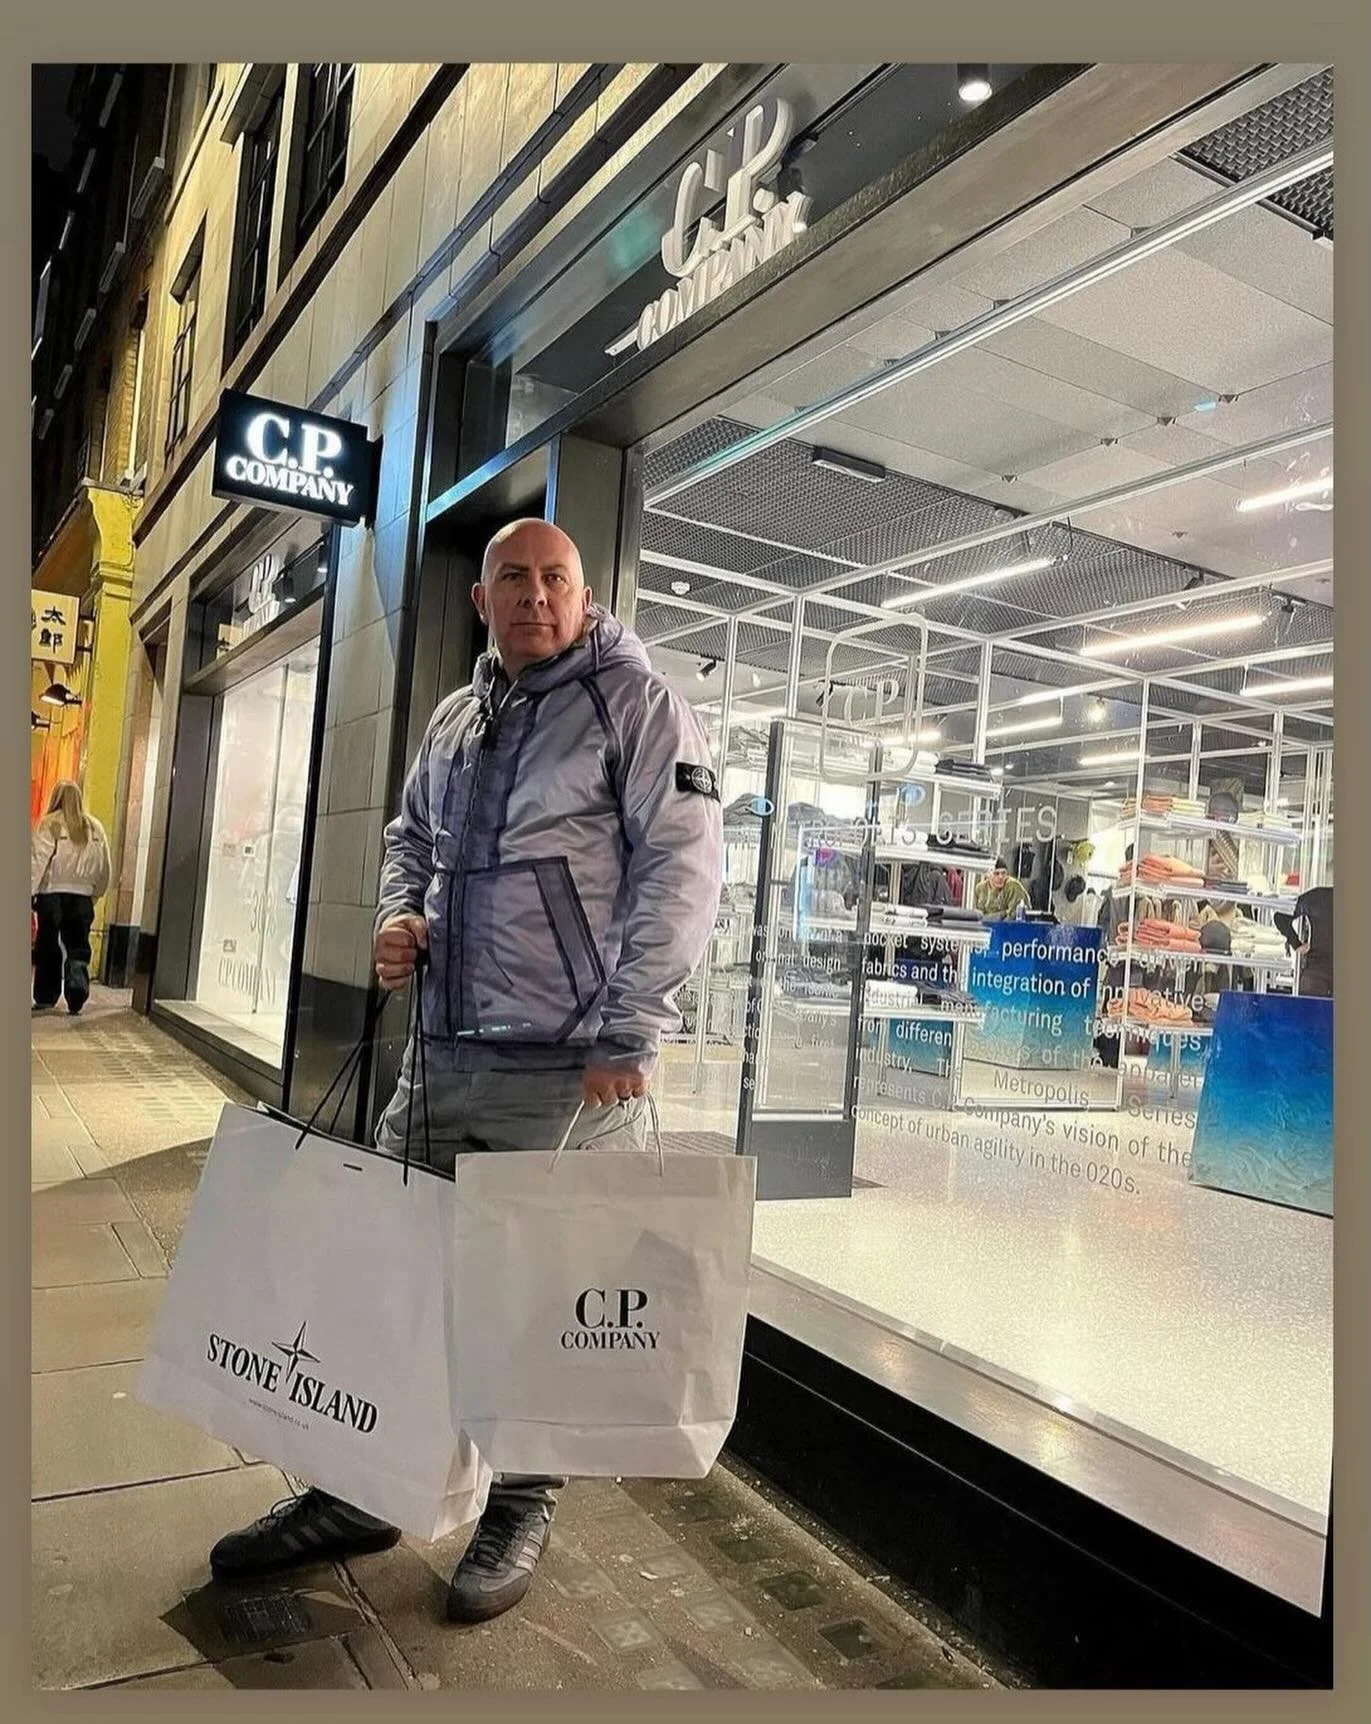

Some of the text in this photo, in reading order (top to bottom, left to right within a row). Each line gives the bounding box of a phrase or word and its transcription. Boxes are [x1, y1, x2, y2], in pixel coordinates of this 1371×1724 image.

[247, 412, 343, 478] C.P.
[225, 455, 354, 506] COMPANY
[802, 951, 841, 975] design
[920, 935, 988, 958] systes,
[1002, 938, 1119, 967] performance
[861, 956, 1204, 1012] fabrics and th integration of innvative
[896, 1020, 956, 1047] differen
[940, 1000, 1063, 1036] manfacturing
[936, 1058, 960, 1080] Th
[994, 1069, 1090, 1106] Metropolis
[1128, 1094, 1196, 1130] Series
[851, 1103, 1140, 1195] concept of urban agility in the 020s.
[965, 1096, 1055, 1137] Company's
[1063, 1120, 1119, 1151] vision
[1128, 1135, 1150, 1158] of
[1158, 1141, 1193, 1168] the
[575, 1287, 649, 1330] C.P.
[560, 1330, 661, 1350] COMPANY
[206, 1333, 378, 1434] STONE ISLAND
